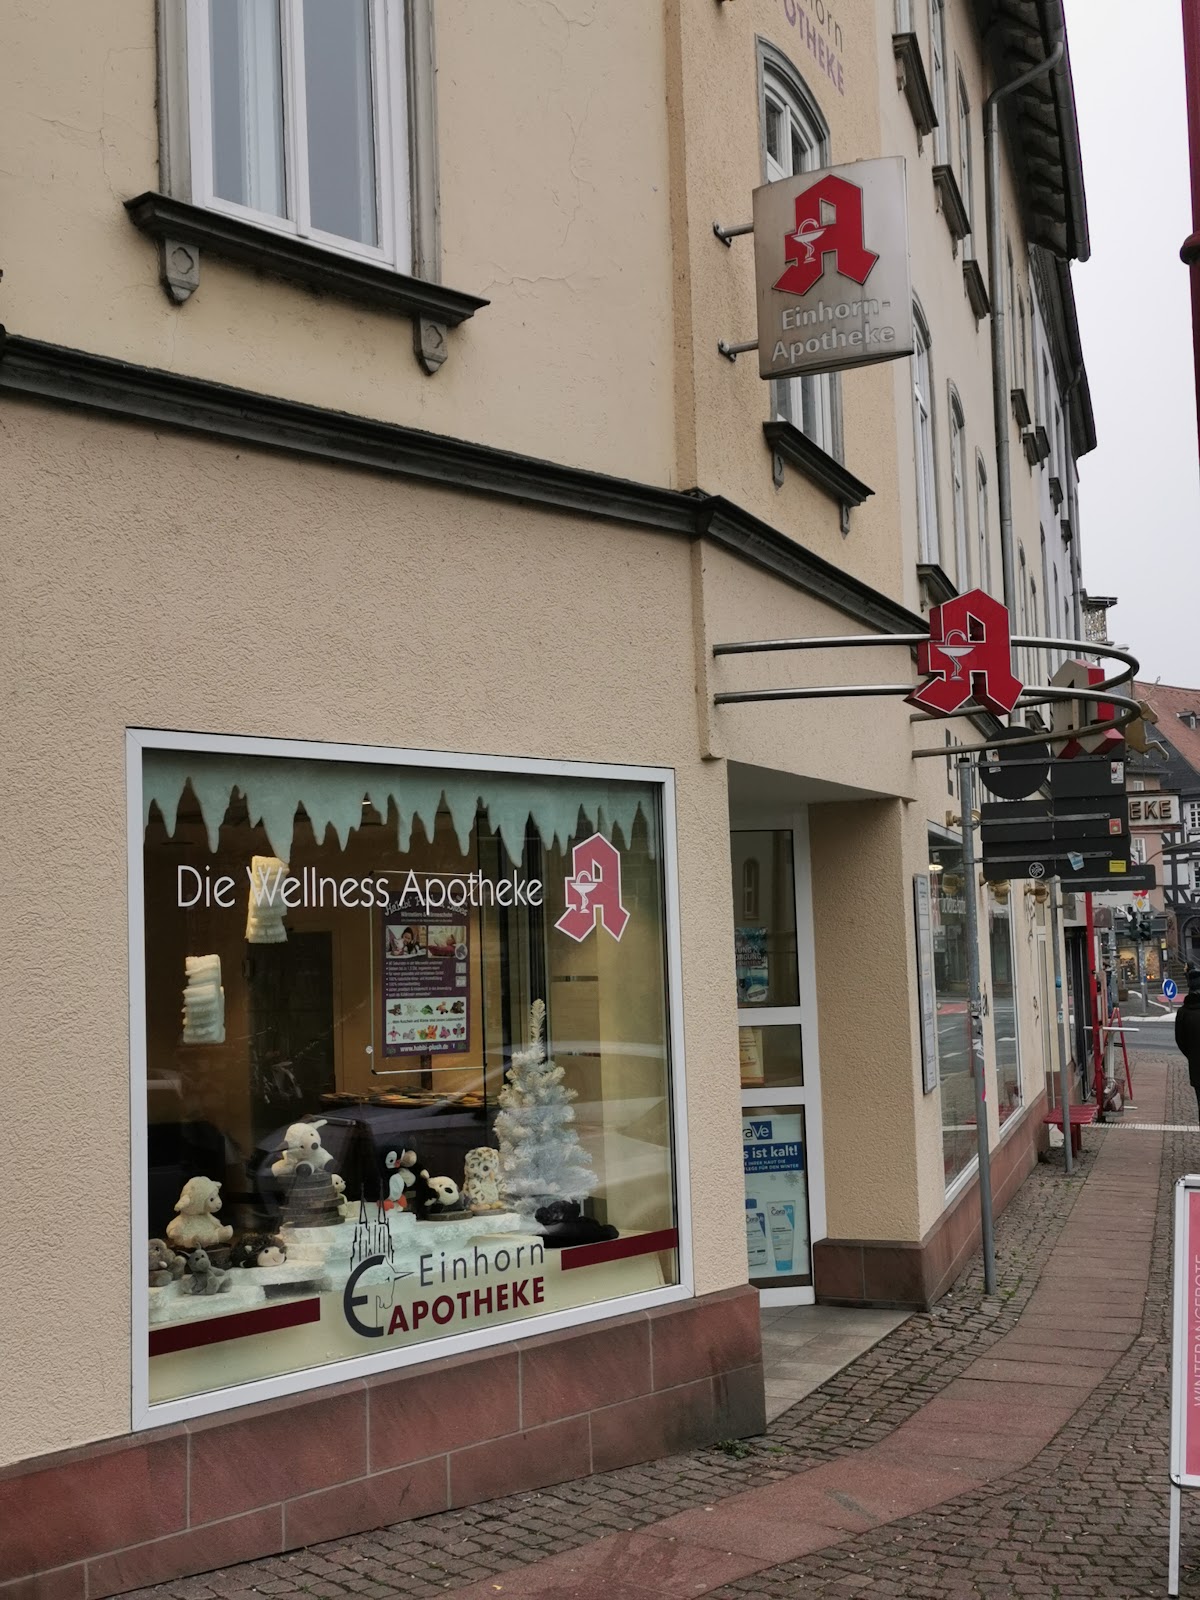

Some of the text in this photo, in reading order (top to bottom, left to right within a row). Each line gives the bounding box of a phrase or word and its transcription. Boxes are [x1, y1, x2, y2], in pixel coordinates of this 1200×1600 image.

[781, 0, 844, 97] OTHEKE
[804, 0, 843, 53] orn
[782, 298, 890, 331] Einhorn-
[772, 322, 895, 364] Apotheke
[176, 865, 544, 916] Die Wellness Apotheke
[752, 1147, 768, 1159] ist
[770, 1144, 798, 1157] kalt!
[420, 1243, 544, 1287] Einhorn
[387, 1276, 545, 1335] APOTHEKE
